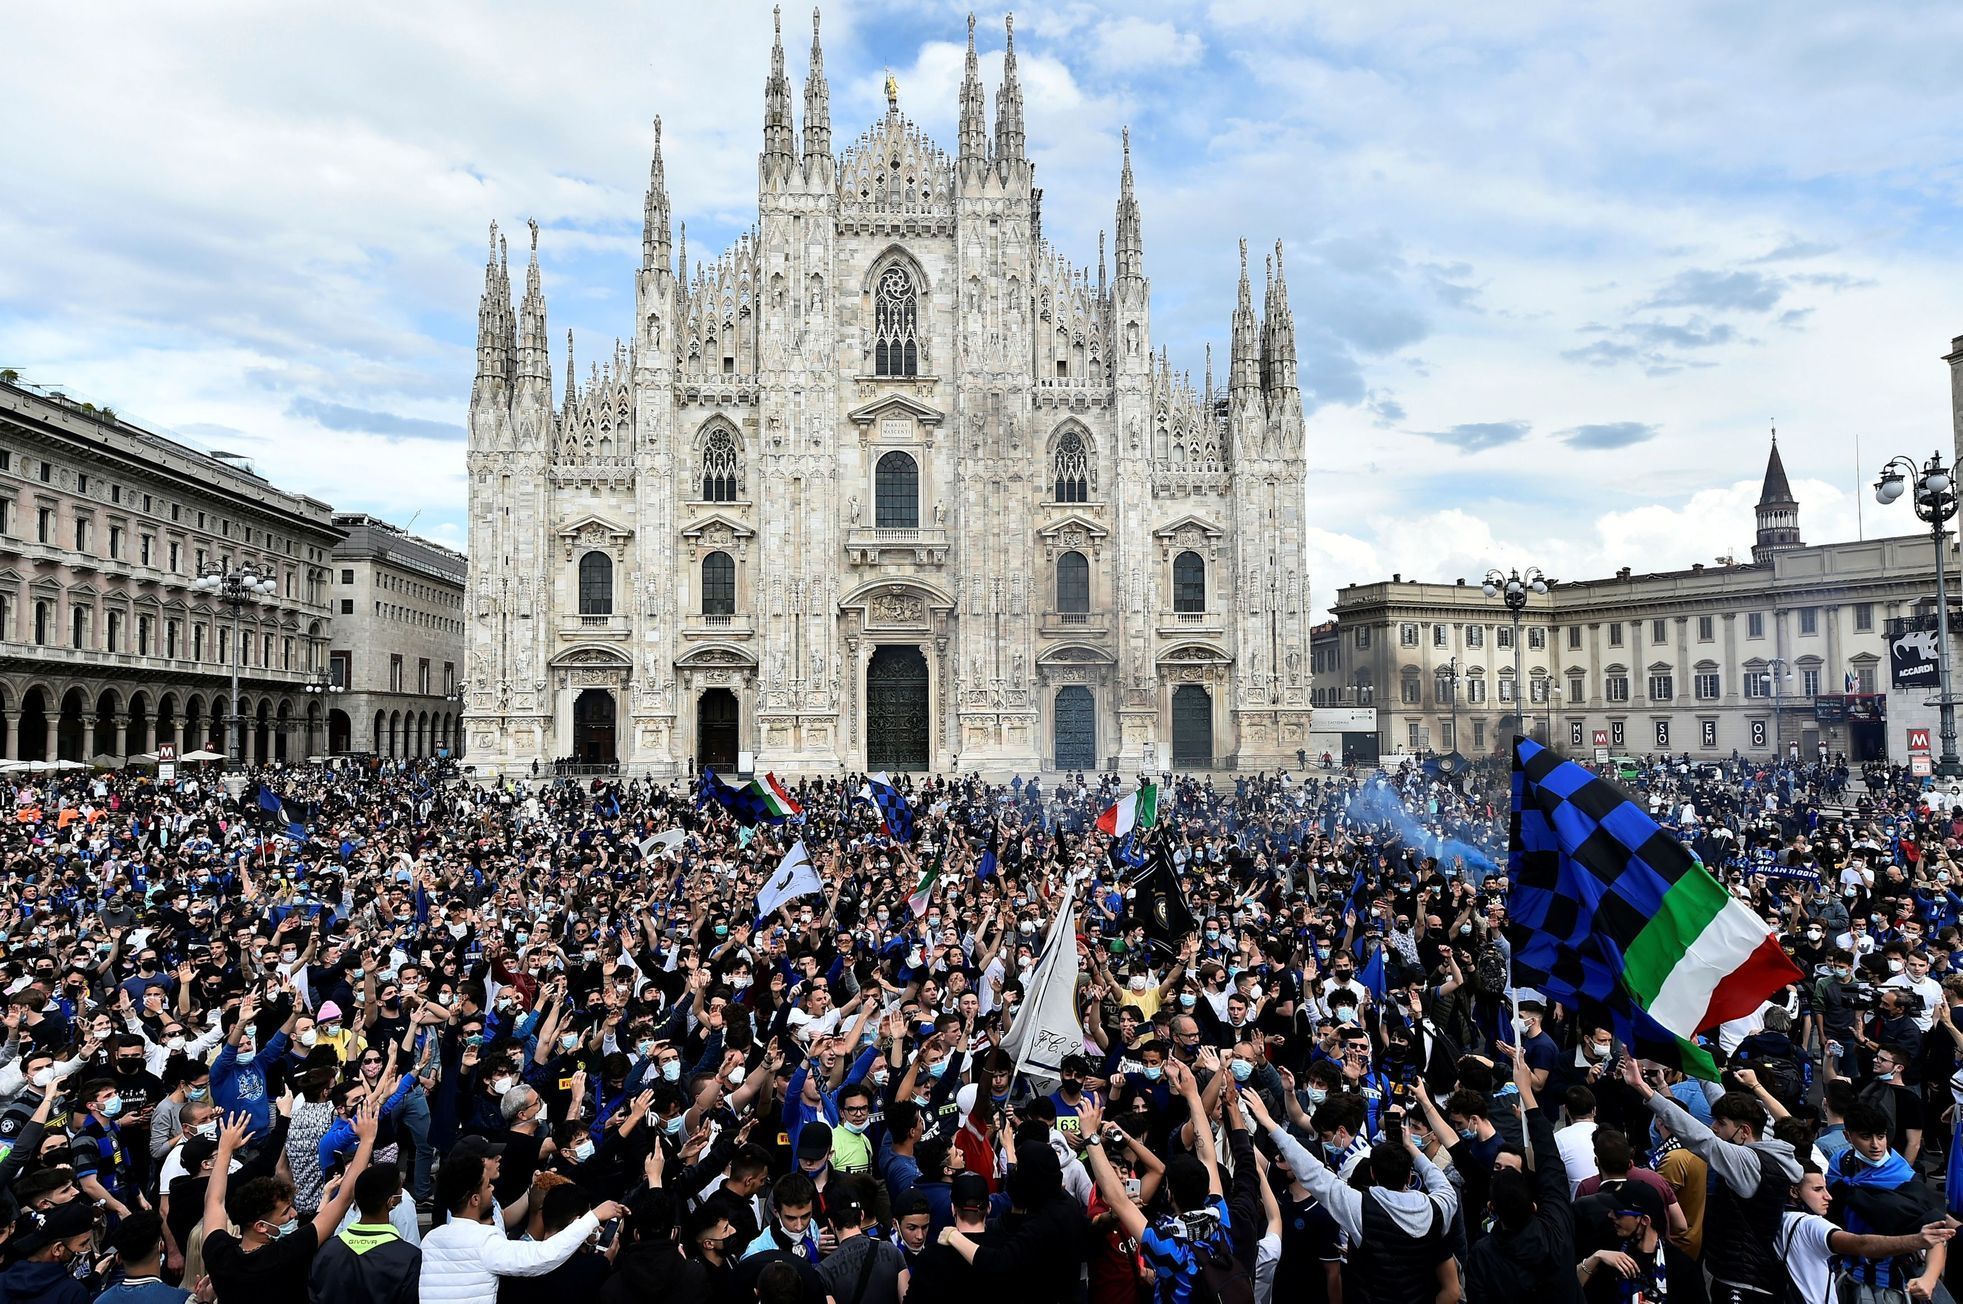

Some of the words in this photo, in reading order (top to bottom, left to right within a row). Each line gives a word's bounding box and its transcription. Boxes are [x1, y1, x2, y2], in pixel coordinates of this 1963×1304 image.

[1899, 664, 1933, 677] ACCARDI
[1595, 733, 1606, 743] M
[1911, 733, 1928, 746] M
[160, 746, 174, 757] M
